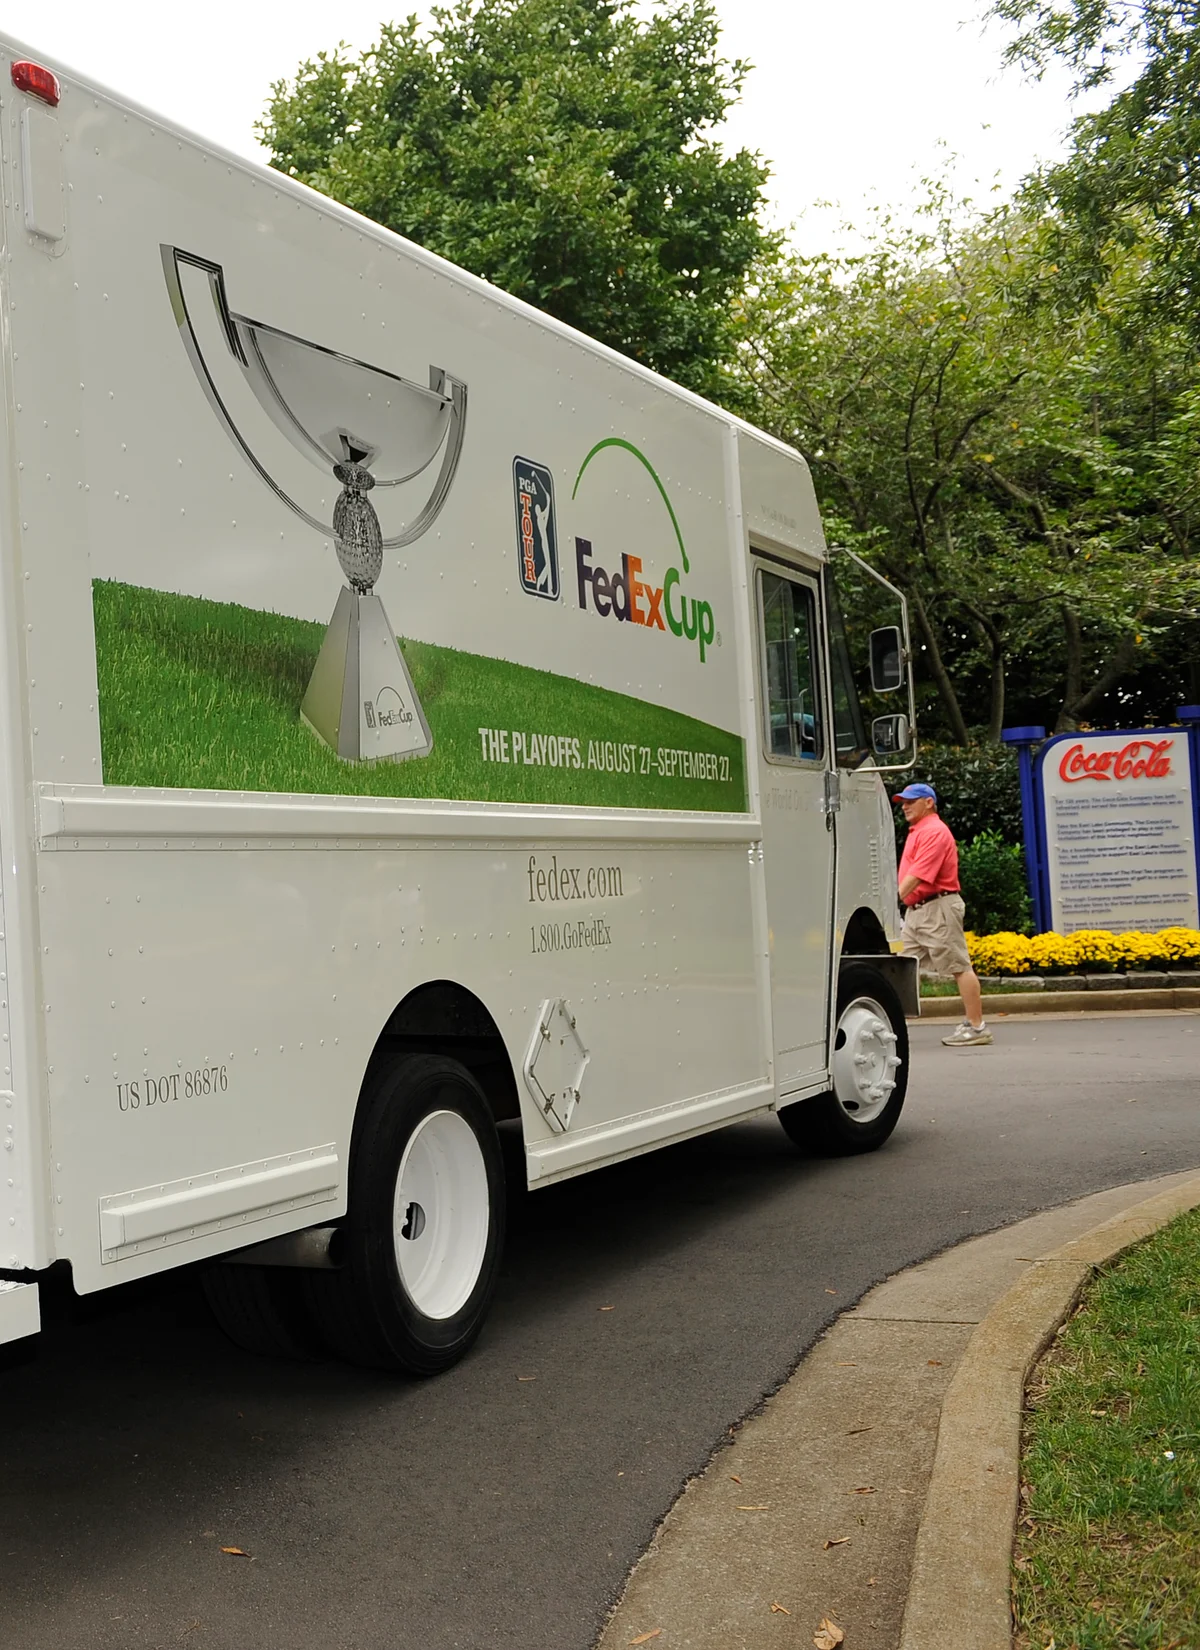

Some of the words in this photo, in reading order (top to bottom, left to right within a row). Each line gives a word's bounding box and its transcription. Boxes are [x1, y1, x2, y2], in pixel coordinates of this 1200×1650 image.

[518, 476, 538, 495] PGA
[519, 492, 536, 583] TOUR
[575, 536, 714, 664] FedExCup
[478, 728, 510, 763] THE
[511, 731, 585, 769] PLAYOFFS.
[587, 740, 637, 774] AUGUST
[719, 756, 733, 782] 27.
[1059, 740, 1174, 783] Coca-Cola
[527, 855, 624, 902] fedex.com
[530, 919, 612, 954] 1.800.GoFedEx
[116, 1081, 141, 1112] US
[145, 1073, 181, 1107] DOT
[184, 1064, 228, 1099] 86876
